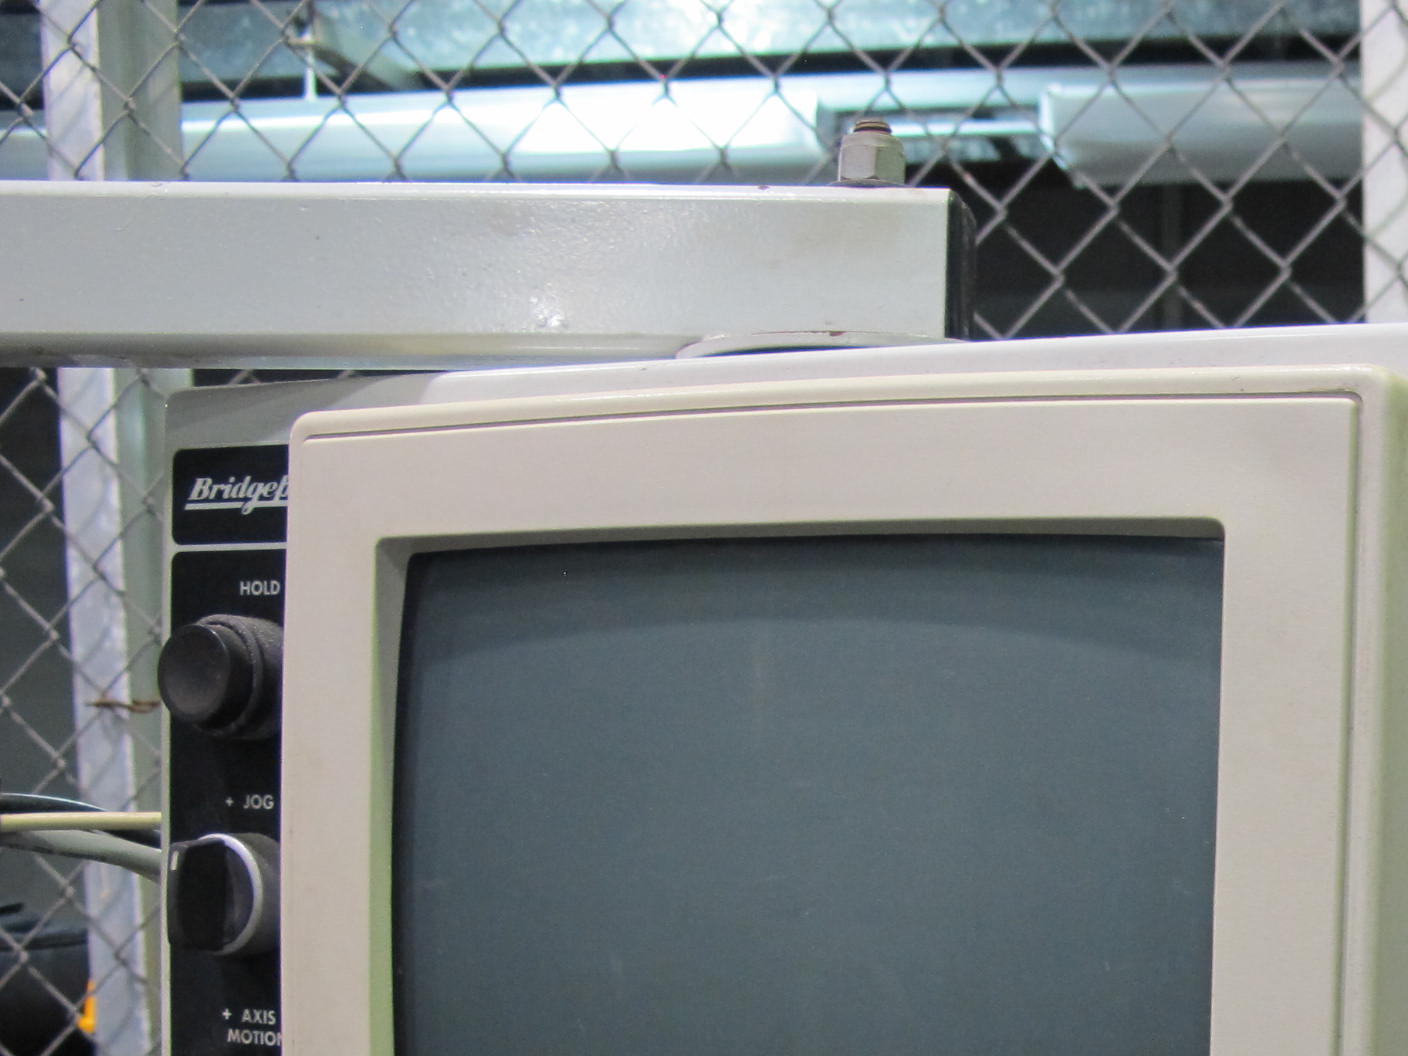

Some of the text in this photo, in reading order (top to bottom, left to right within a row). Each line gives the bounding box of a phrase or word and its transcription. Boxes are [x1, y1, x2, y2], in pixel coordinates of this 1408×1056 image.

[239, 579, 281, 596] HOLD
[243, 794, 275, 810] JOG
[241, 1008, 277, 1025] AXIS
